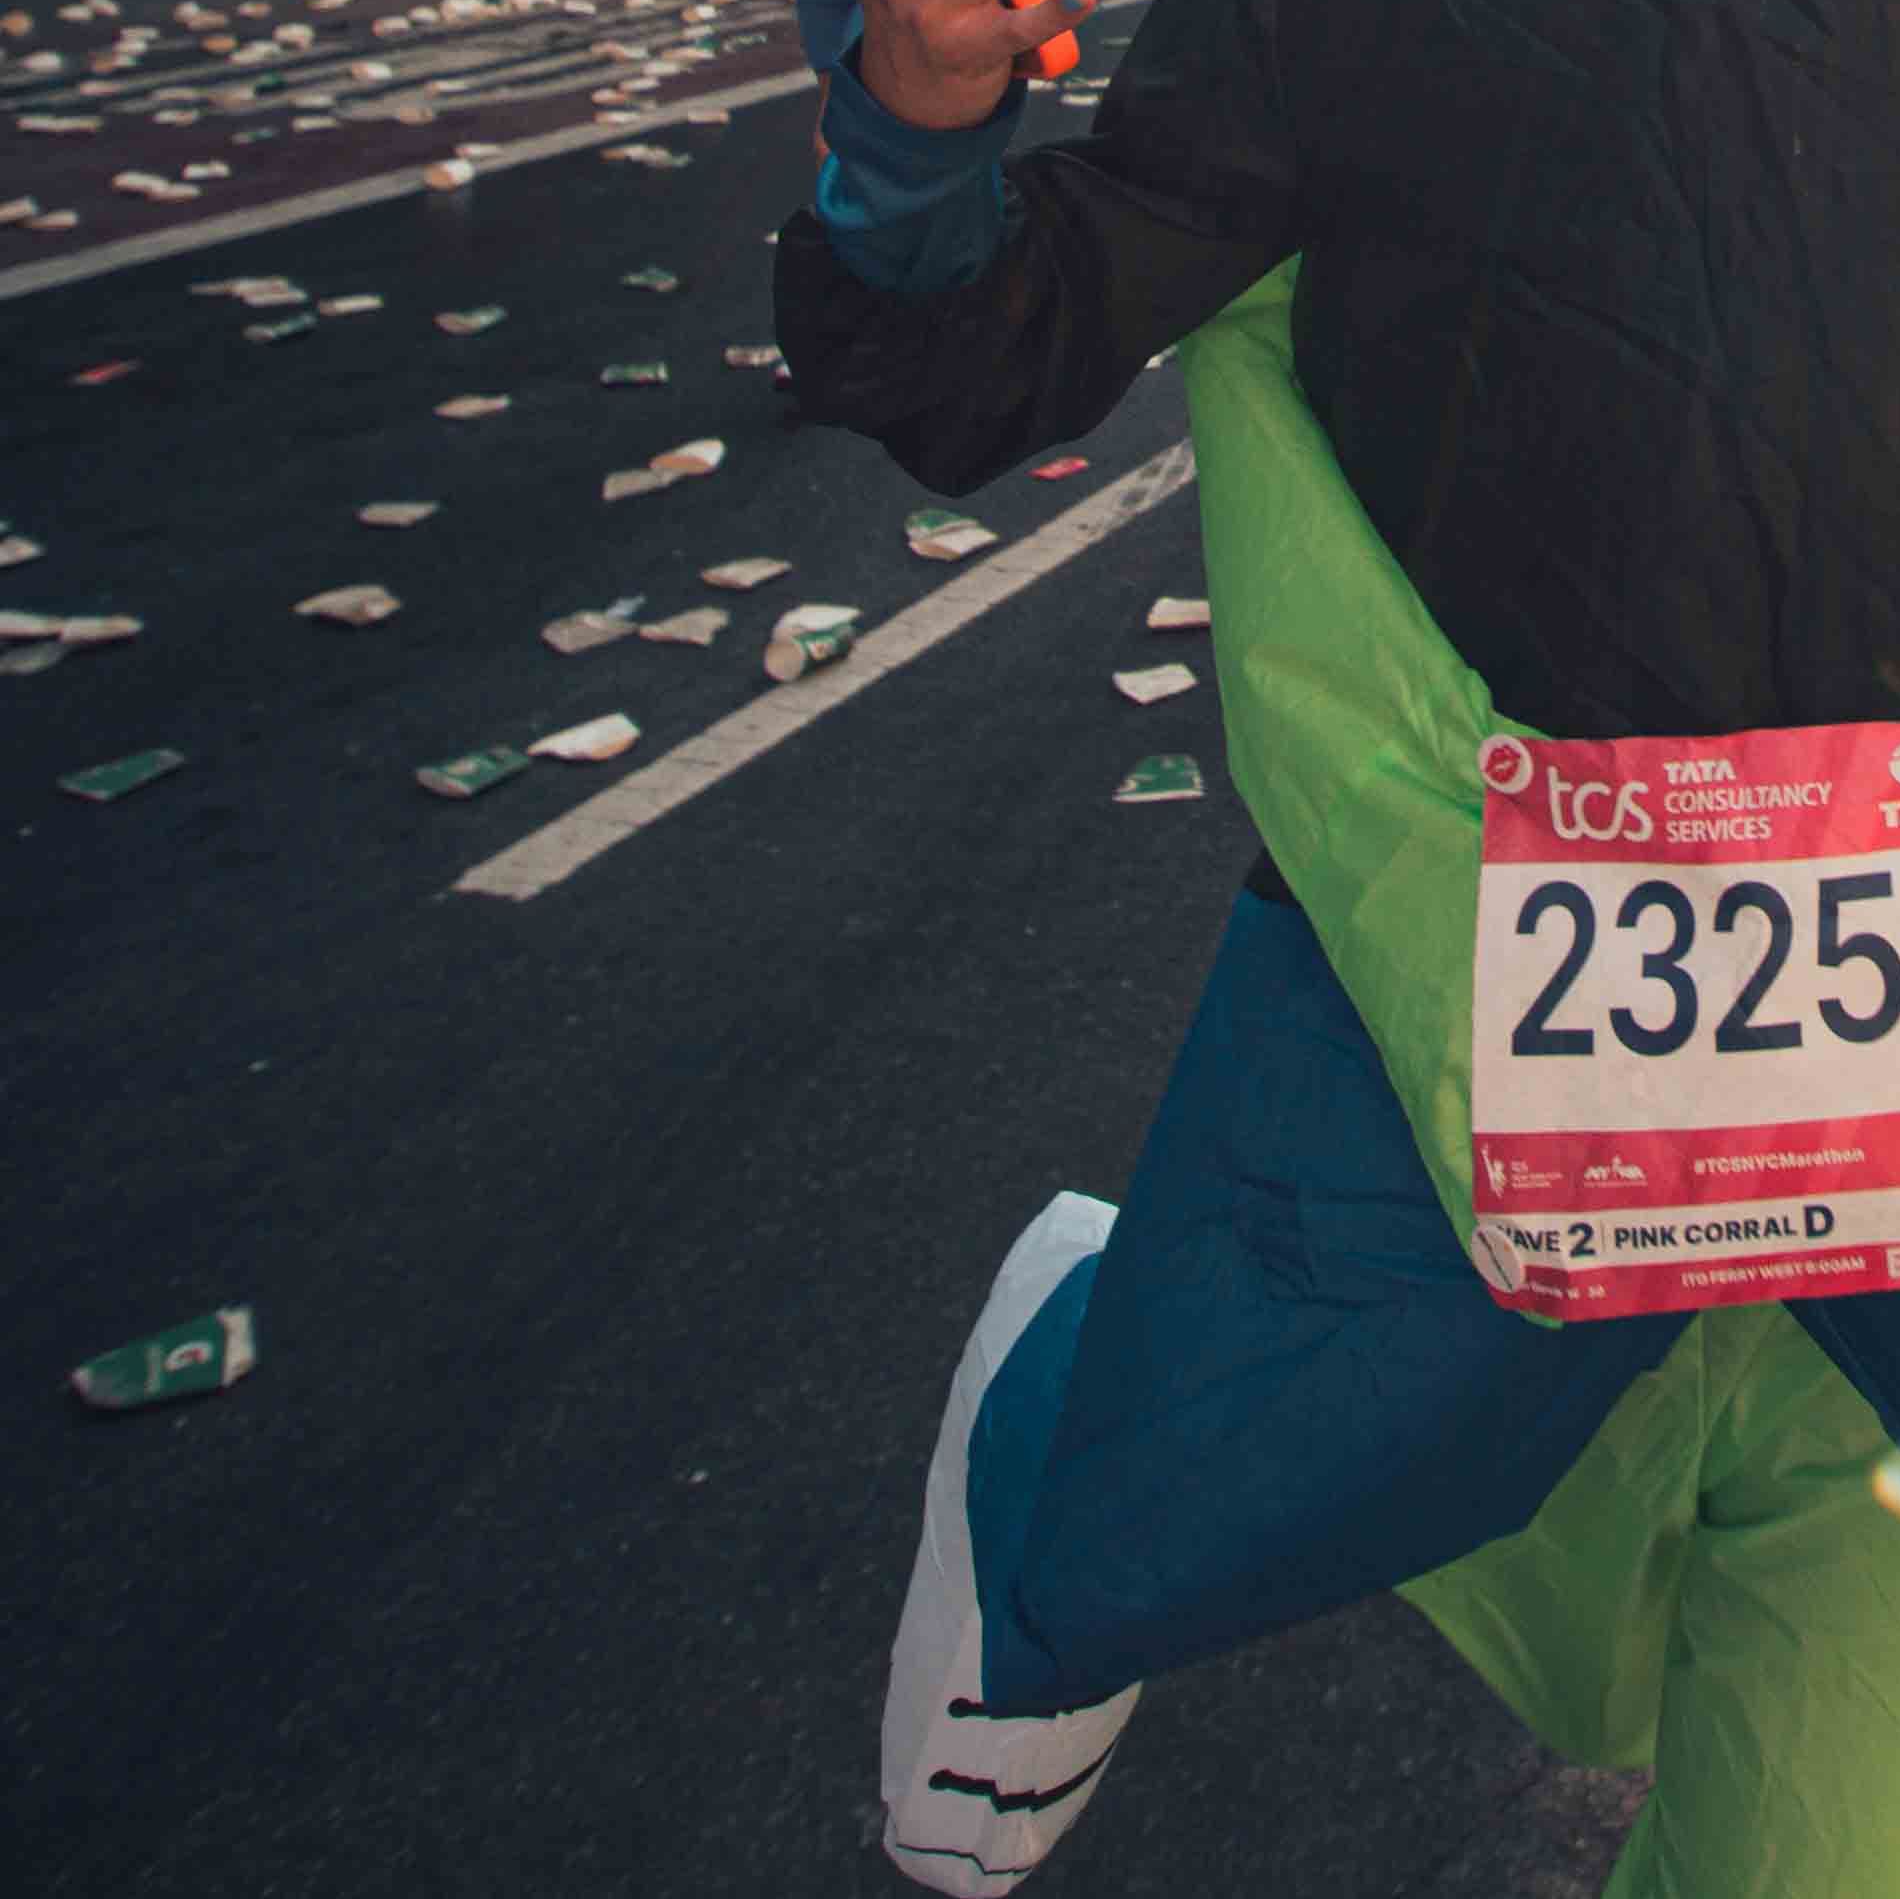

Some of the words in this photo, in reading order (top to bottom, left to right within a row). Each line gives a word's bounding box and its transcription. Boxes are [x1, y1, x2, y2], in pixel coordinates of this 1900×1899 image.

[1664, 759, 1736, 784] TATA
[1547, 765, 1653, 842] tcs
[1664, 781, 1832, 814] CONSULTANCY
[1665, 816, 1772, 843] SERVICES
[1499, 1226, 1561, 1252] AVE
[1567, 1222, 1597, 1257] 2
[1613, 1226, 1677, 1249] PINK
[1684, 1216, 1798, 1245] CORRAL
[1804, 1205, 1835, 1240] D
